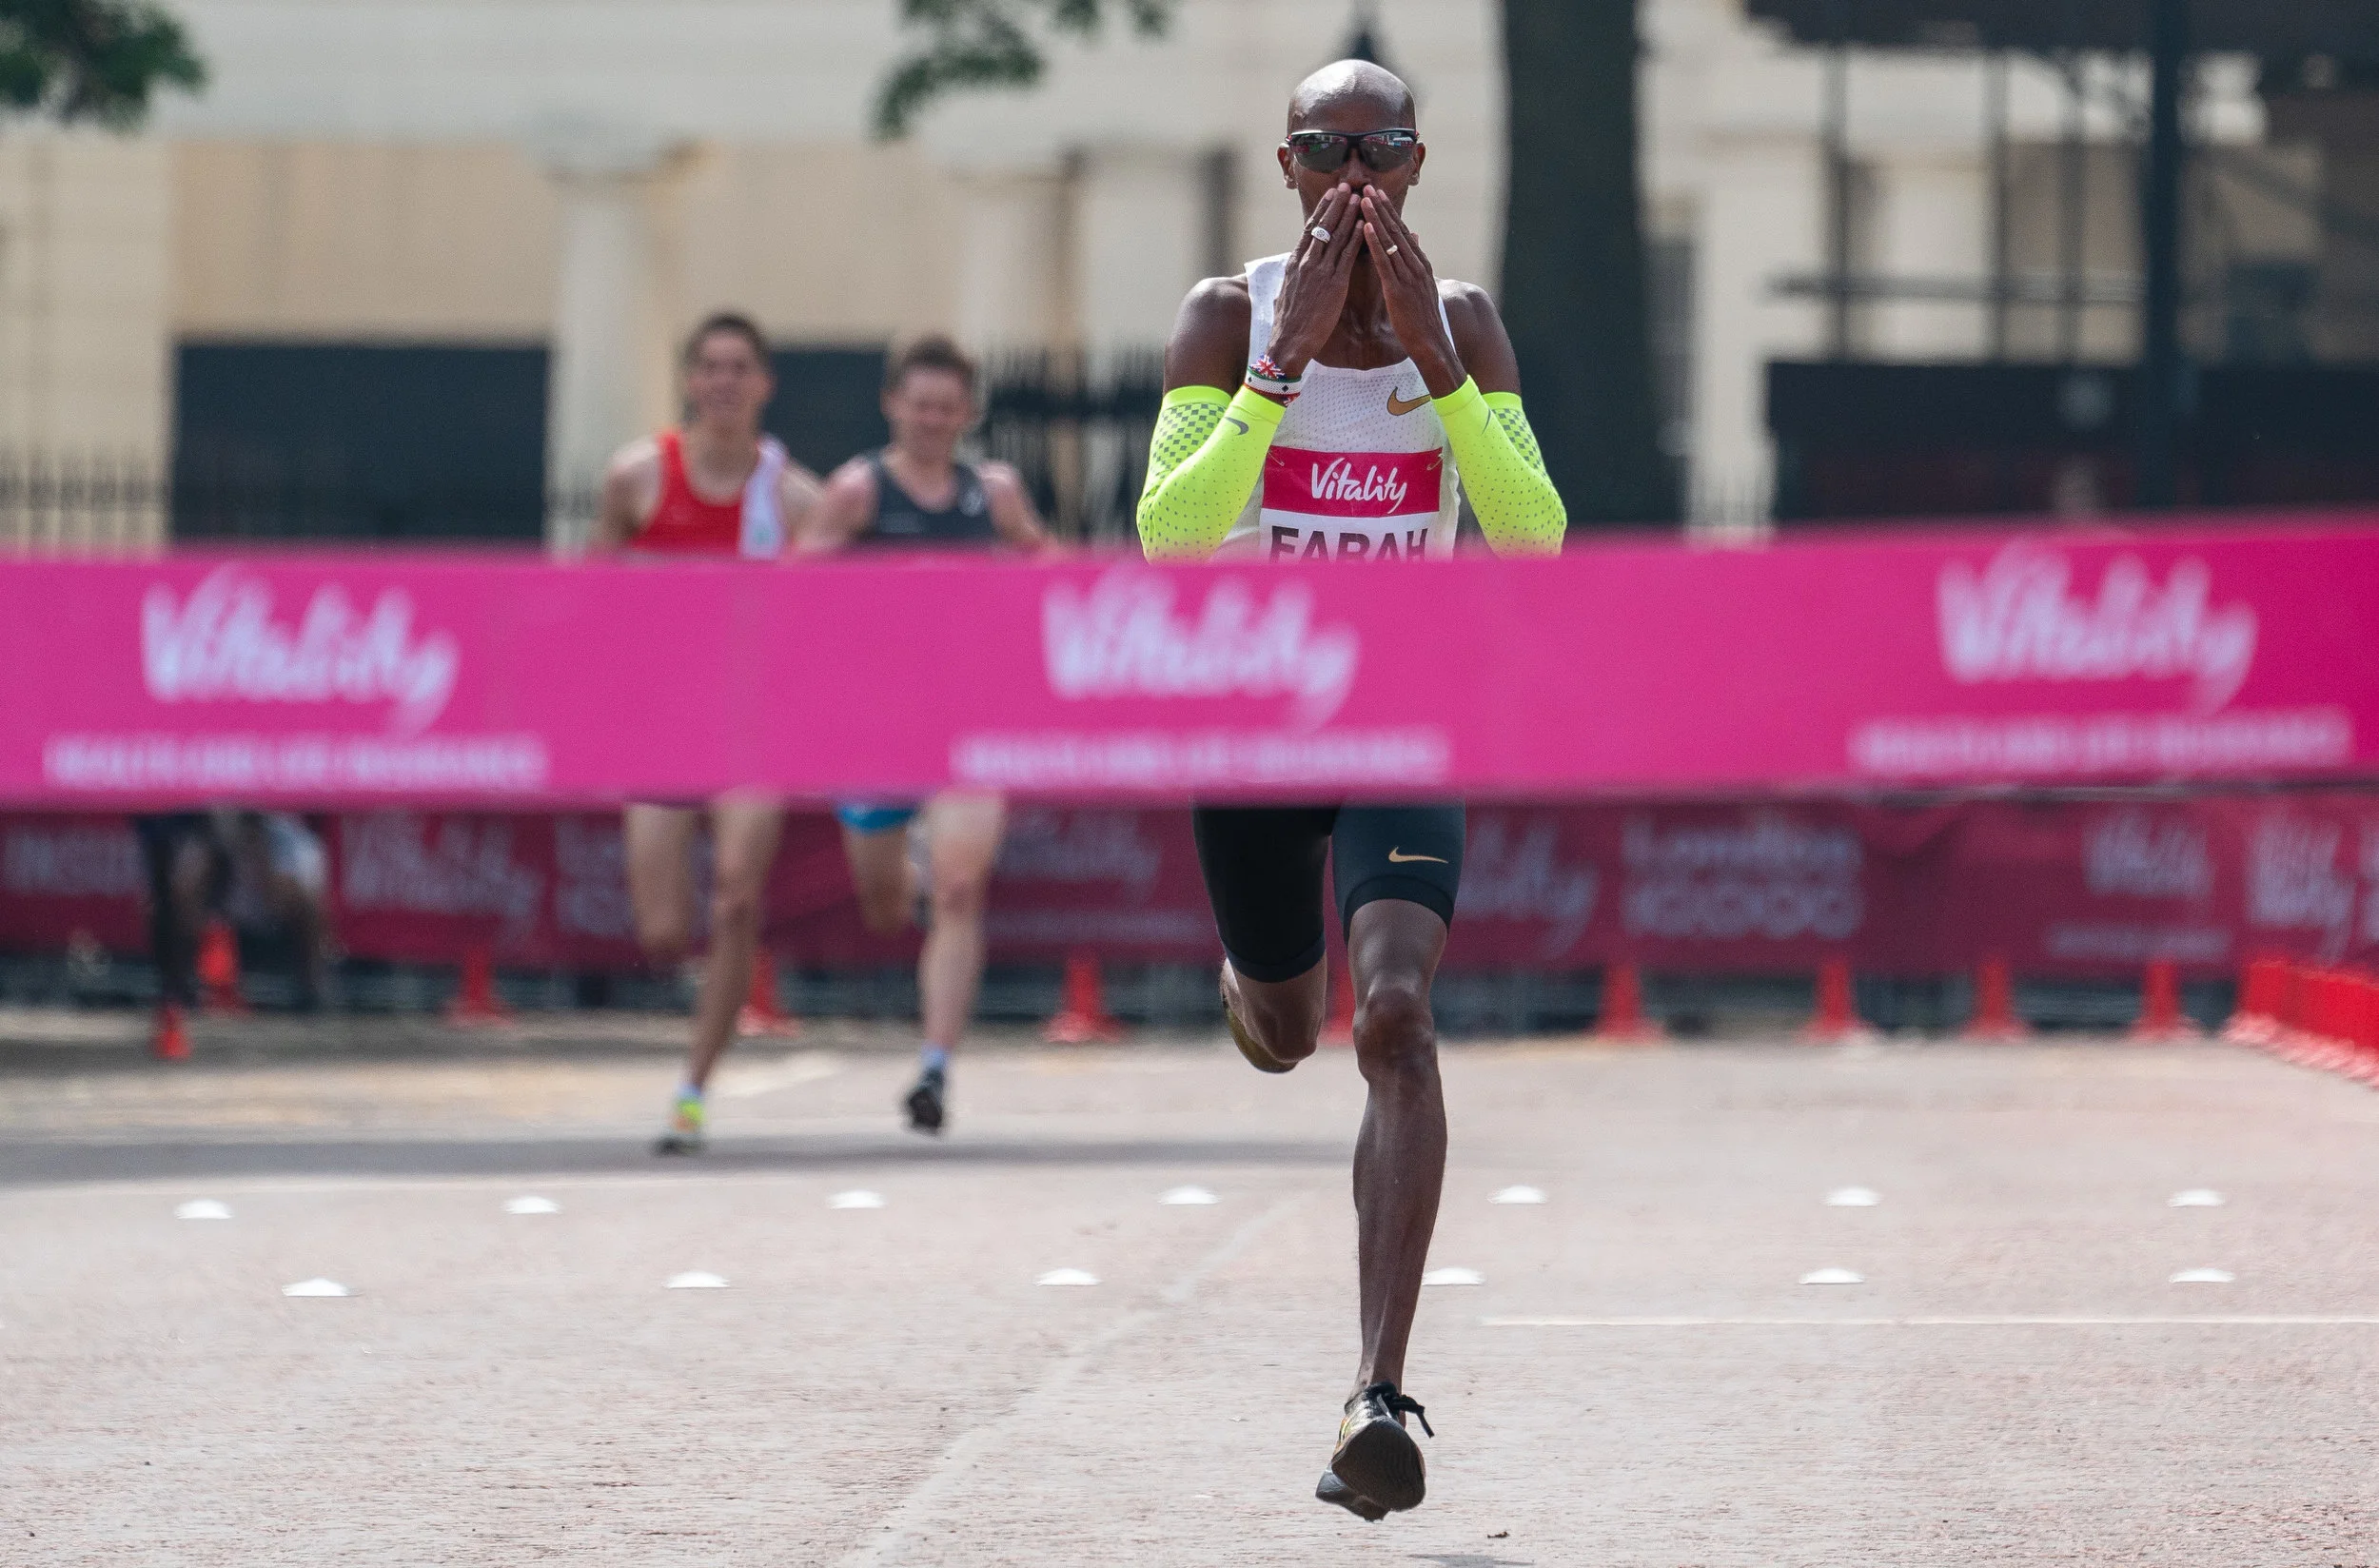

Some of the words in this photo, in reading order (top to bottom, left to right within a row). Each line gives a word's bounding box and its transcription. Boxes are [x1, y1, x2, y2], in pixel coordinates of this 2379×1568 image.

[1311, 458, 1407, 514] Vitality
[1269, 525, 1428, 562] FARAH
[143, 565, 457, 735] Vitality
